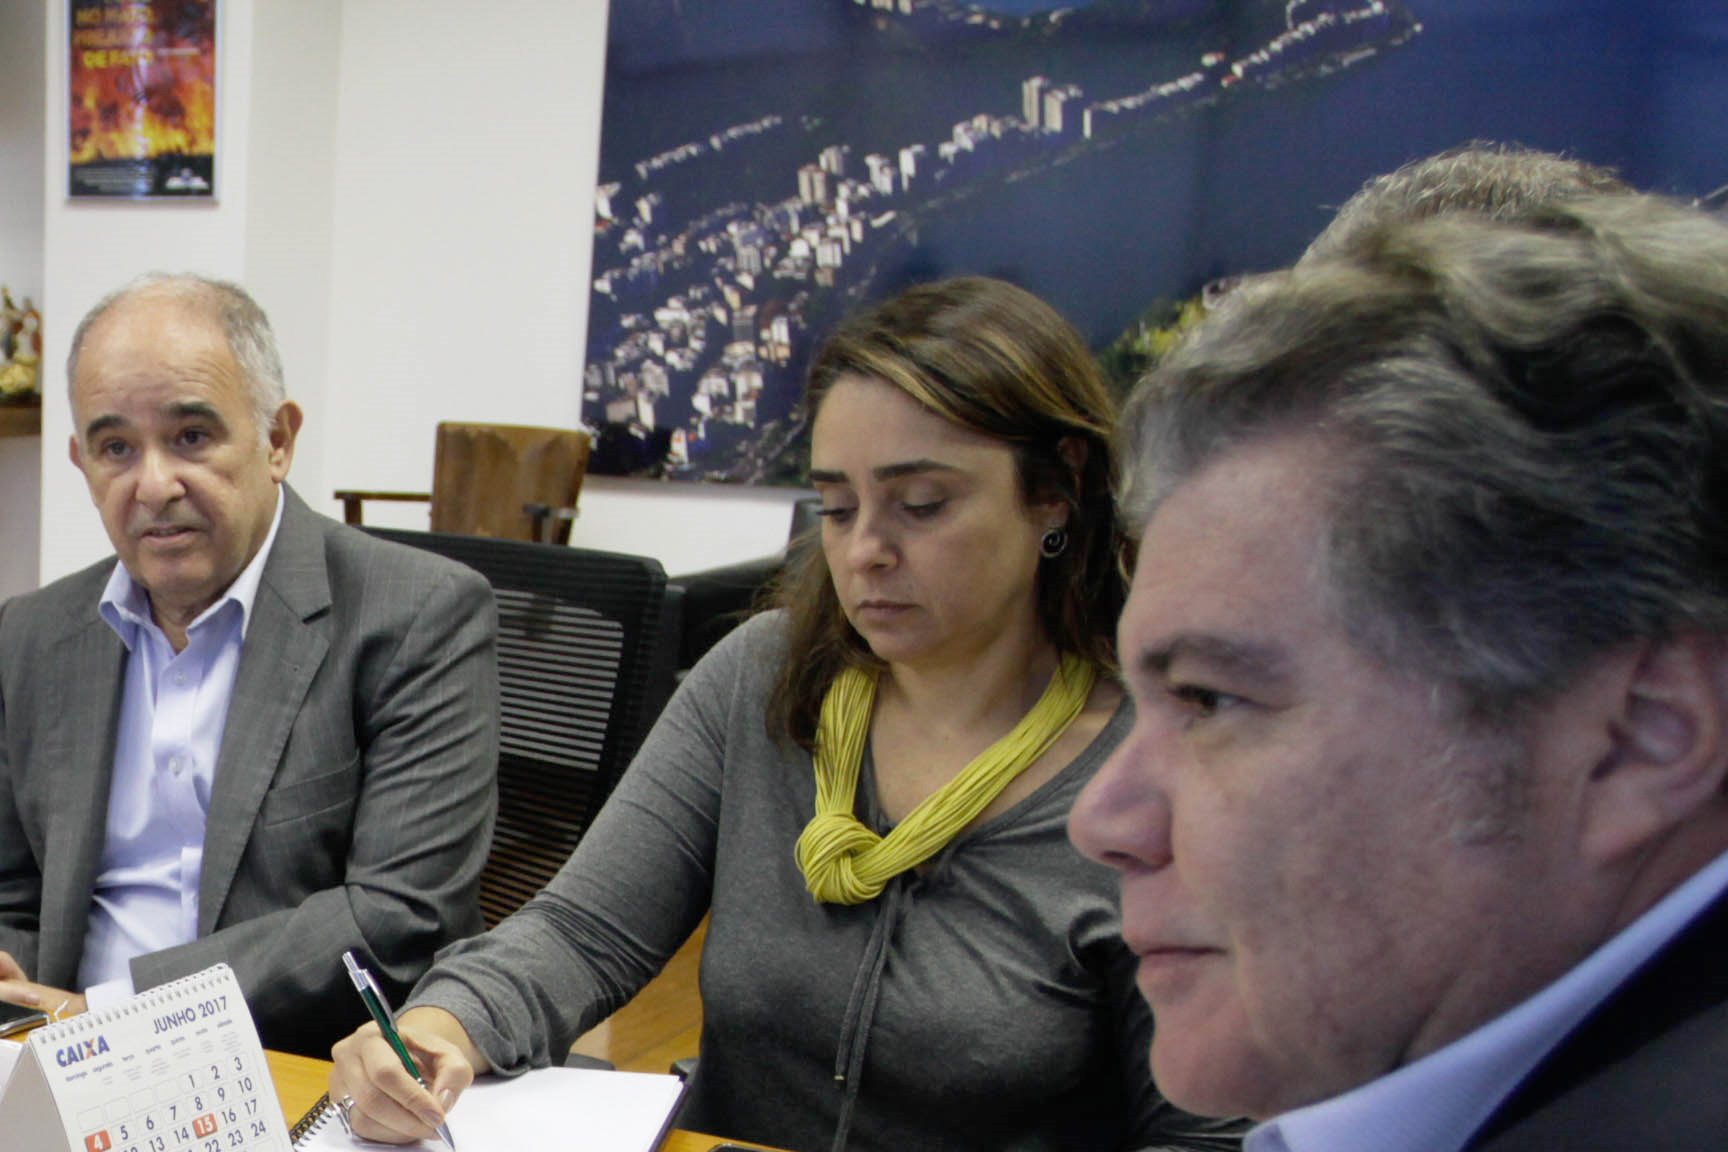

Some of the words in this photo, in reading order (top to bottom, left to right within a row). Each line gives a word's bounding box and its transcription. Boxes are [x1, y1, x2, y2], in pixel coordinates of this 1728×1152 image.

[153, 1007, 196, 1035] JUNHO
[198, 996, 228, 1018] 2017
[56, 1035, 110, 1067] CAIXA
[188, 1074, 195, 1089] 1
[211, 1065, 220, 1080] 2
[234, 1056, 242, 1071] 3
[94, 1134, 104, 1150] 4
[120, 1125, 129, 1141] 5
[145, 1115, 154, 1130] 6
[170, 1105, 177, 1120] 7
[194, 1096, 203, 1111] 8
[217, 1087, 225, 1101] 9
[238, 1077, 253, 1093] 10
[174, 1127, 190, 1144] 14
[197, 1117, 213, 1137] 15
[222, 1108, 237, 1124] 16
[245, 1098, 257, 1115] 17
[228, 1129, 243, 1147] 23
[251, 1120, 266, 1137] 24
